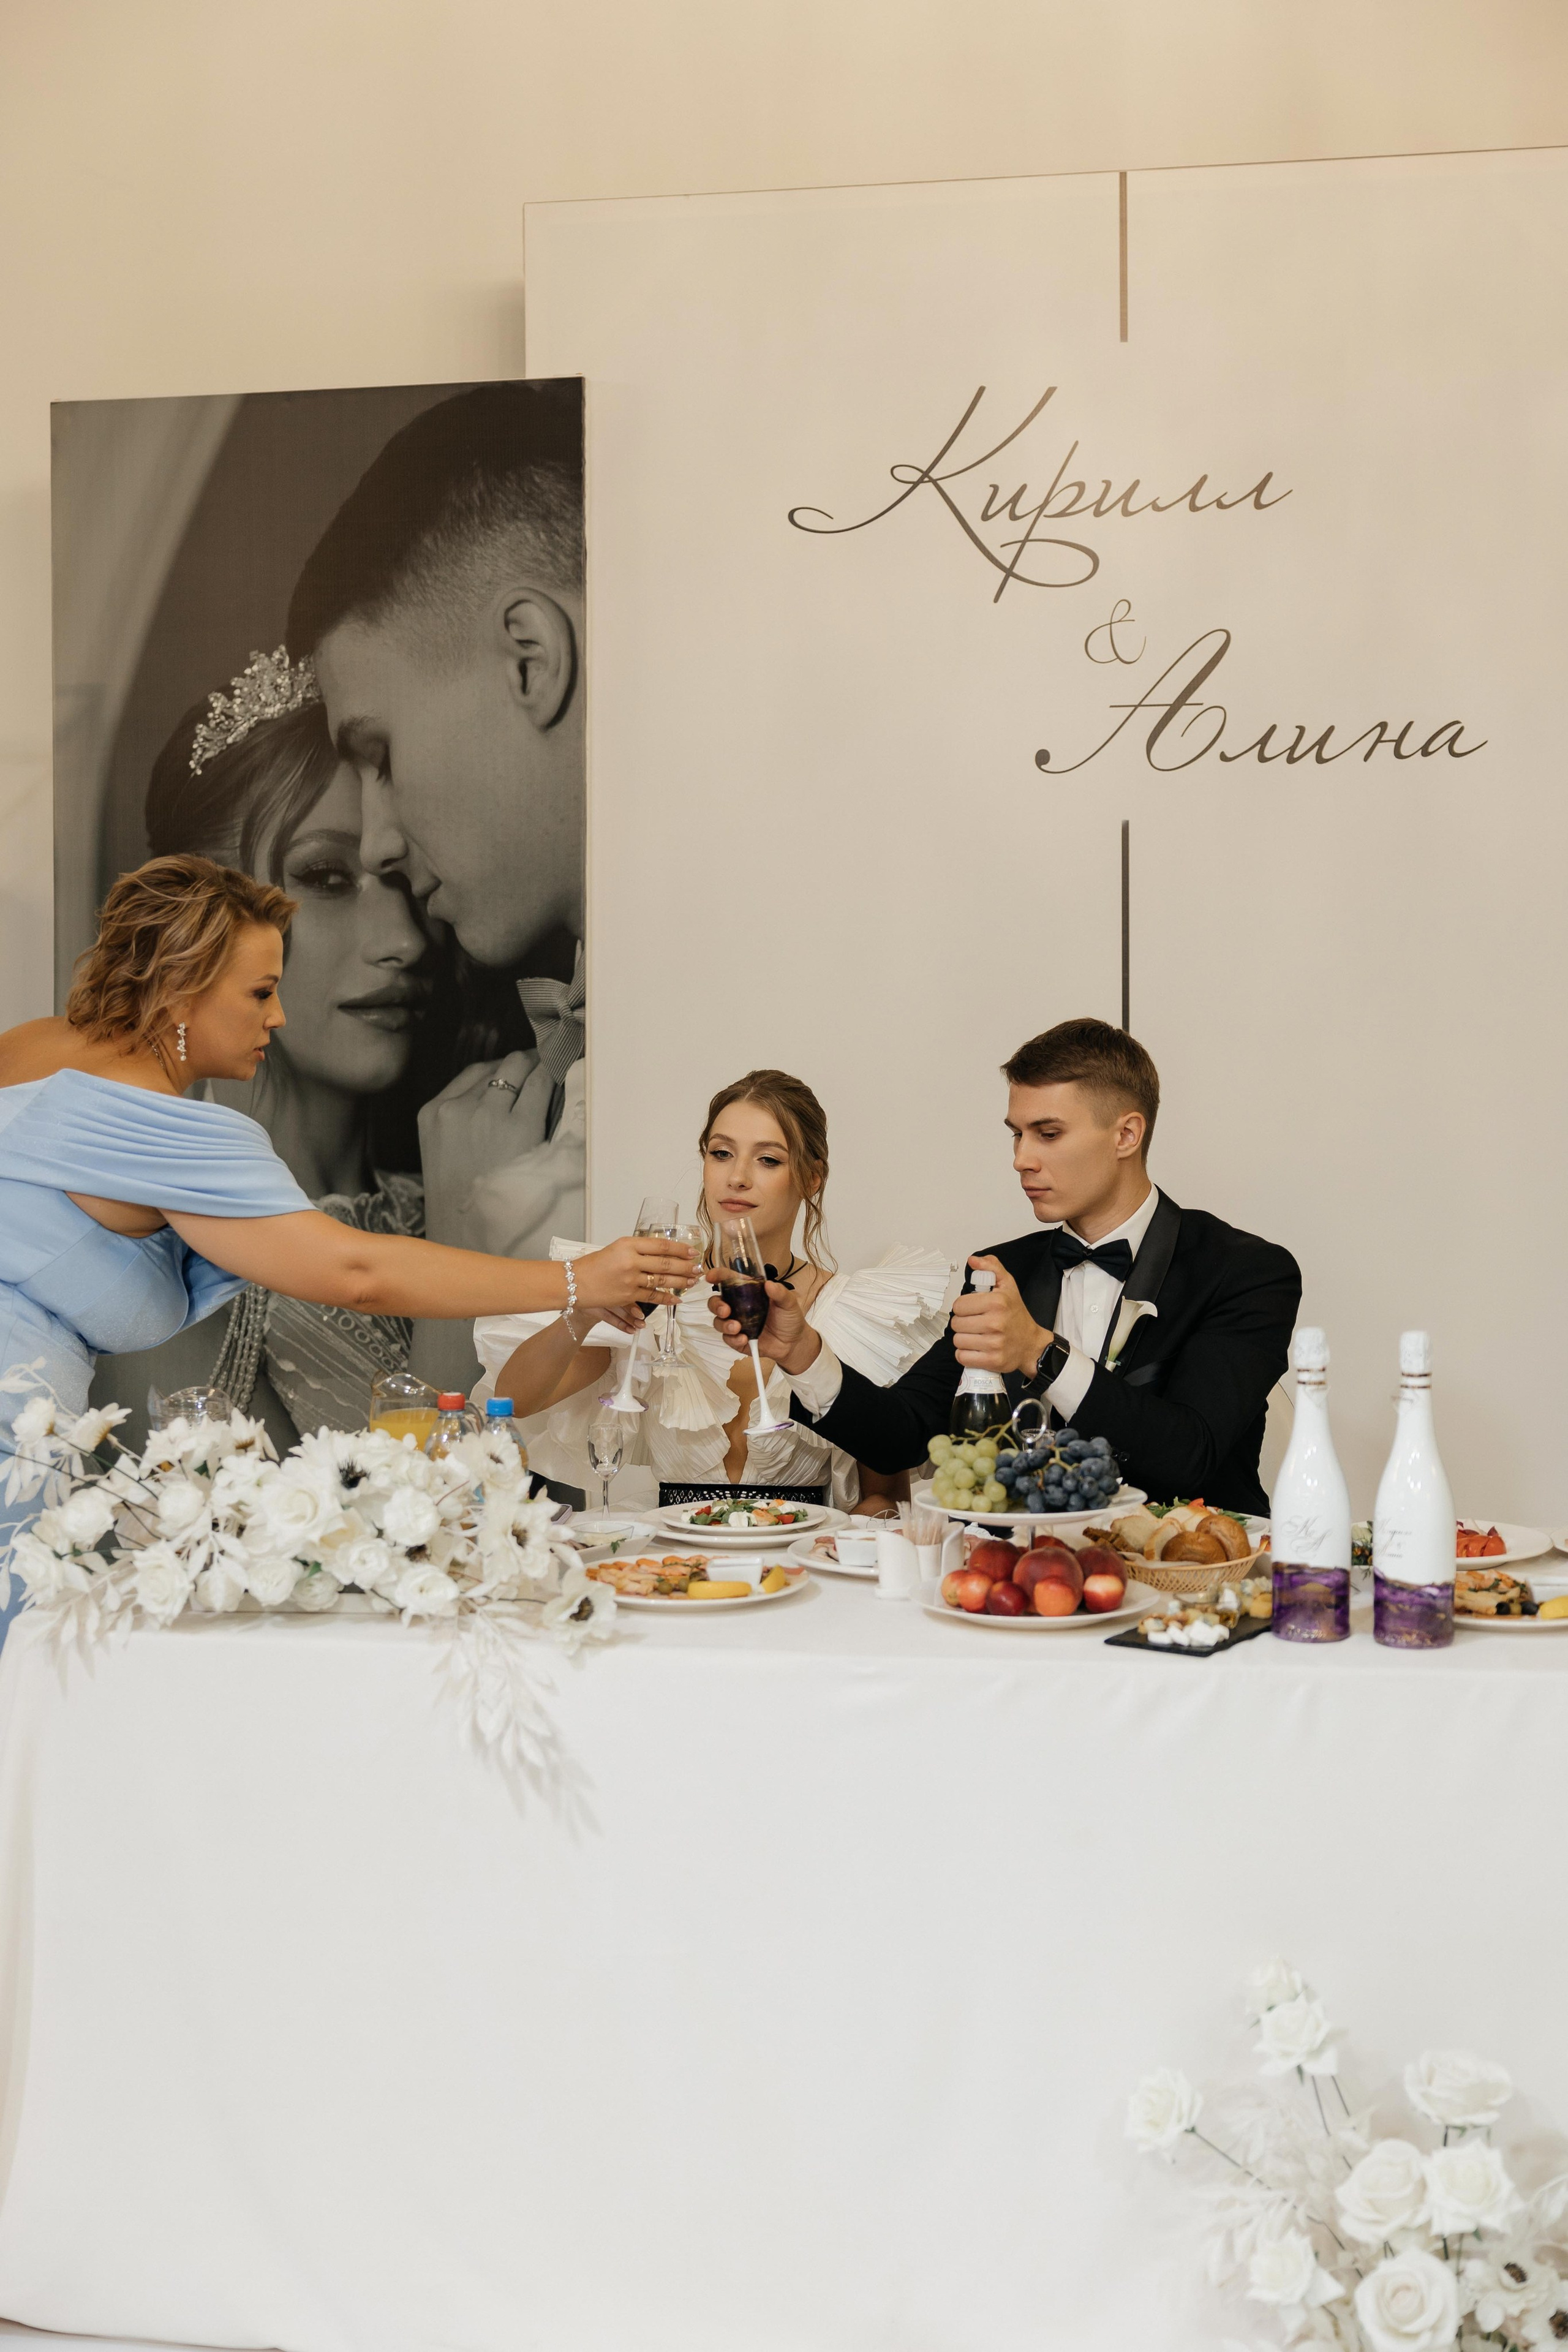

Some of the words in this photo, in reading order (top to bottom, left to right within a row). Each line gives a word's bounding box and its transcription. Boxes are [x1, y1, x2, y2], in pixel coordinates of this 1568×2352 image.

[787, 385, 1294, 605] Кирилл
[1034, 628, 1489, 775] Алина
[1084, 598, 1147, 665] &
